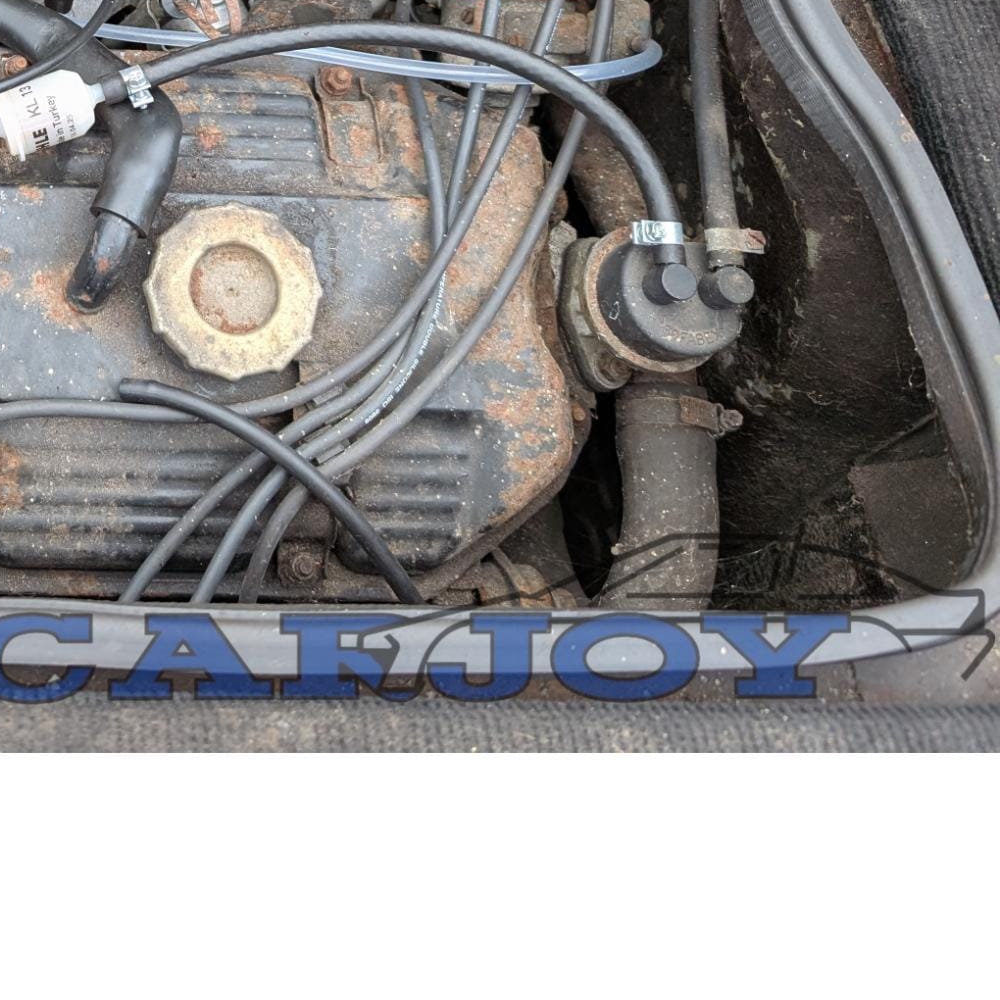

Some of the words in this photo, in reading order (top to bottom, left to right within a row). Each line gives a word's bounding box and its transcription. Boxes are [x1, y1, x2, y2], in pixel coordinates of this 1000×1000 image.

[19, 85, 32, 97] 13
[26, 98, 41, 118] KL
[46, 96, 61, 128] Turkey
[32, 128, 50, 151] HLE
[419, 323, 435, 356] DOUBLE
